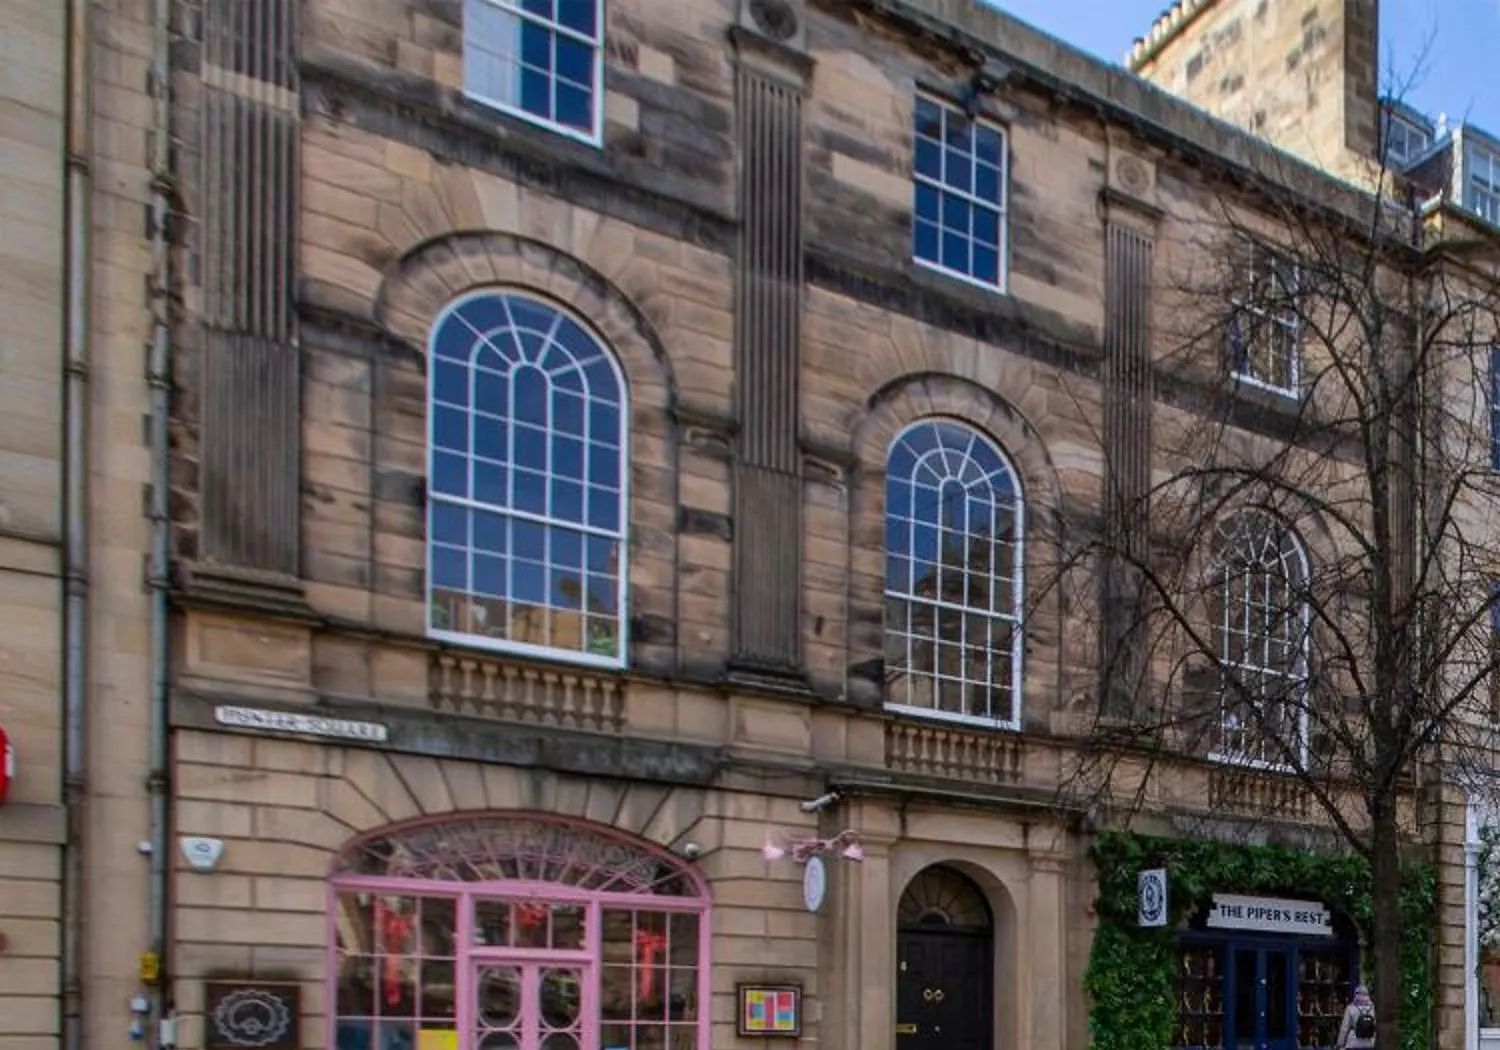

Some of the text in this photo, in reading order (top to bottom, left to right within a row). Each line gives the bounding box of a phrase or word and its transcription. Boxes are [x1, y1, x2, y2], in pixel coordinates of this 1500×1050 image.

[1220, 905, 1323, 925] THE PIPER'S REST
